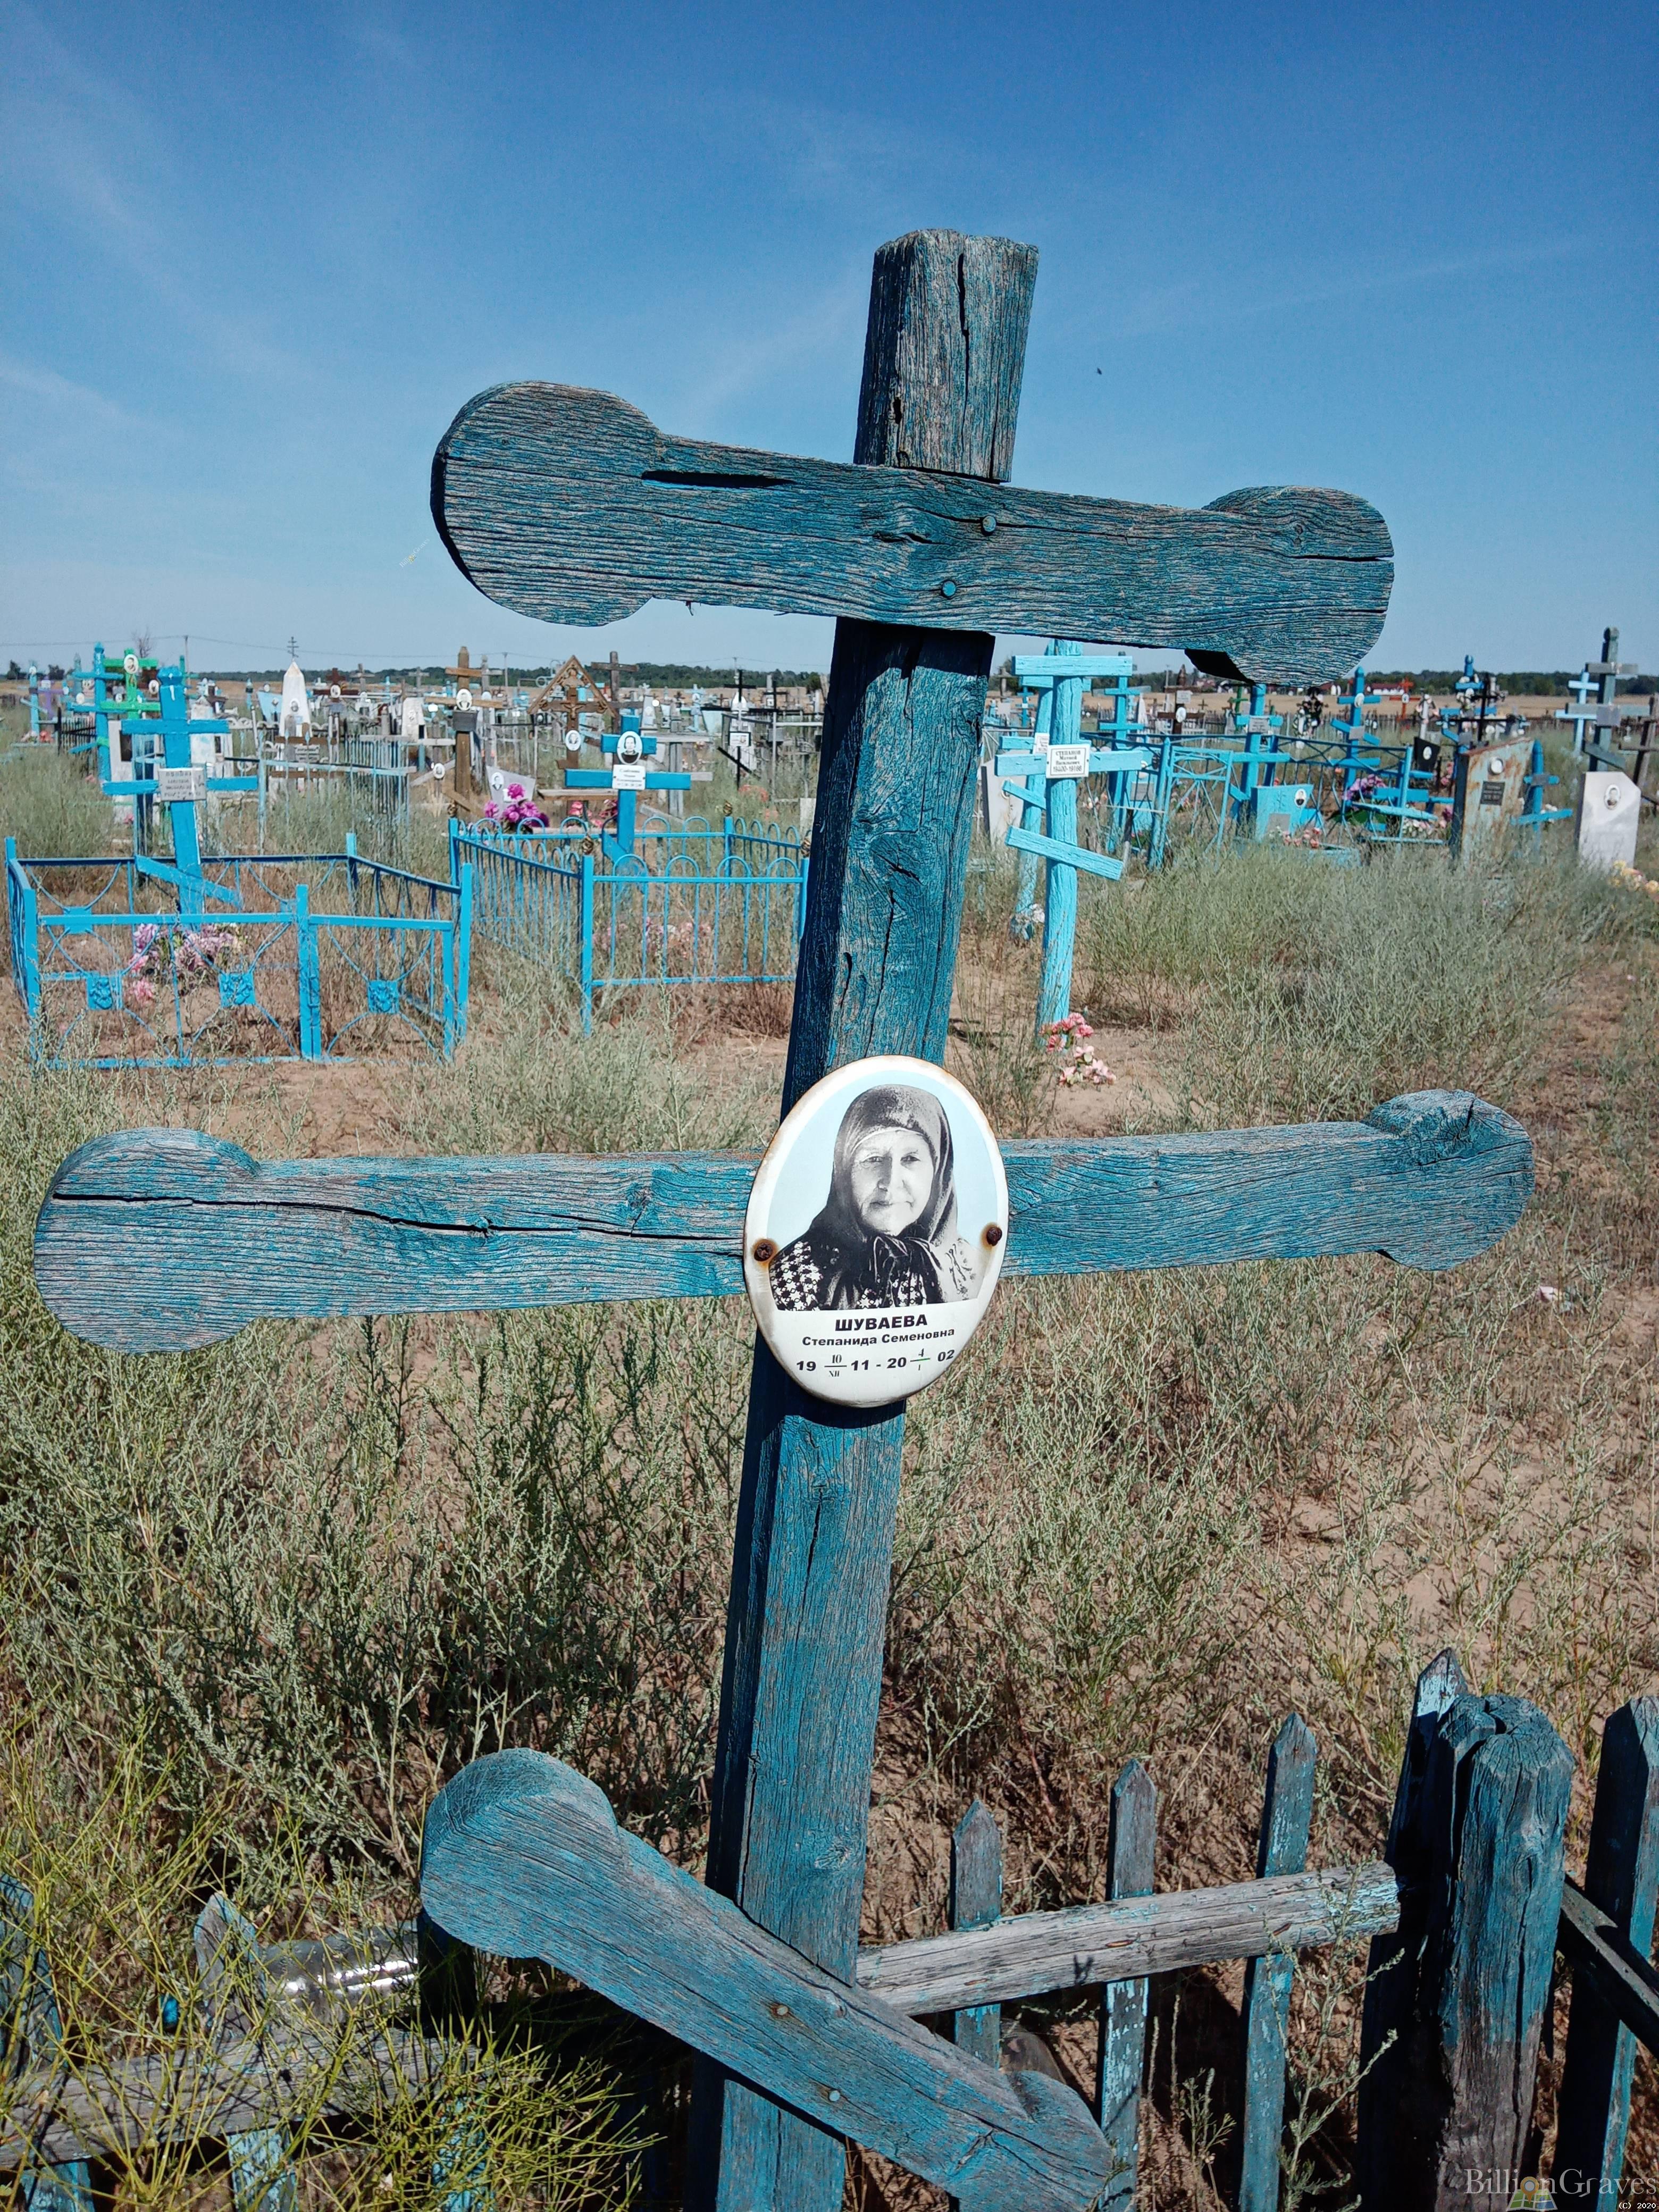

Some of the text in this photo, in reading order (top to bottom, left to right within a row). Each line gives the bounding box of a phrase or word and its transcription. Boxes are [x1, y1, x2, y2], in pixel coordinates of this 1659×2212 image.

[835, 1314, 928, 1331] ШУВАЕВА
[802, 1329, 955, 1346] Степанида Семеновна
[796, 1360, 817, 1371] 19
[832, 1354, 842, 1364] 10
[851, 1359, 869, 1371] 11
[886, 1357, 907, 1369] 20
[937, 1349, 955, 1362] 02
